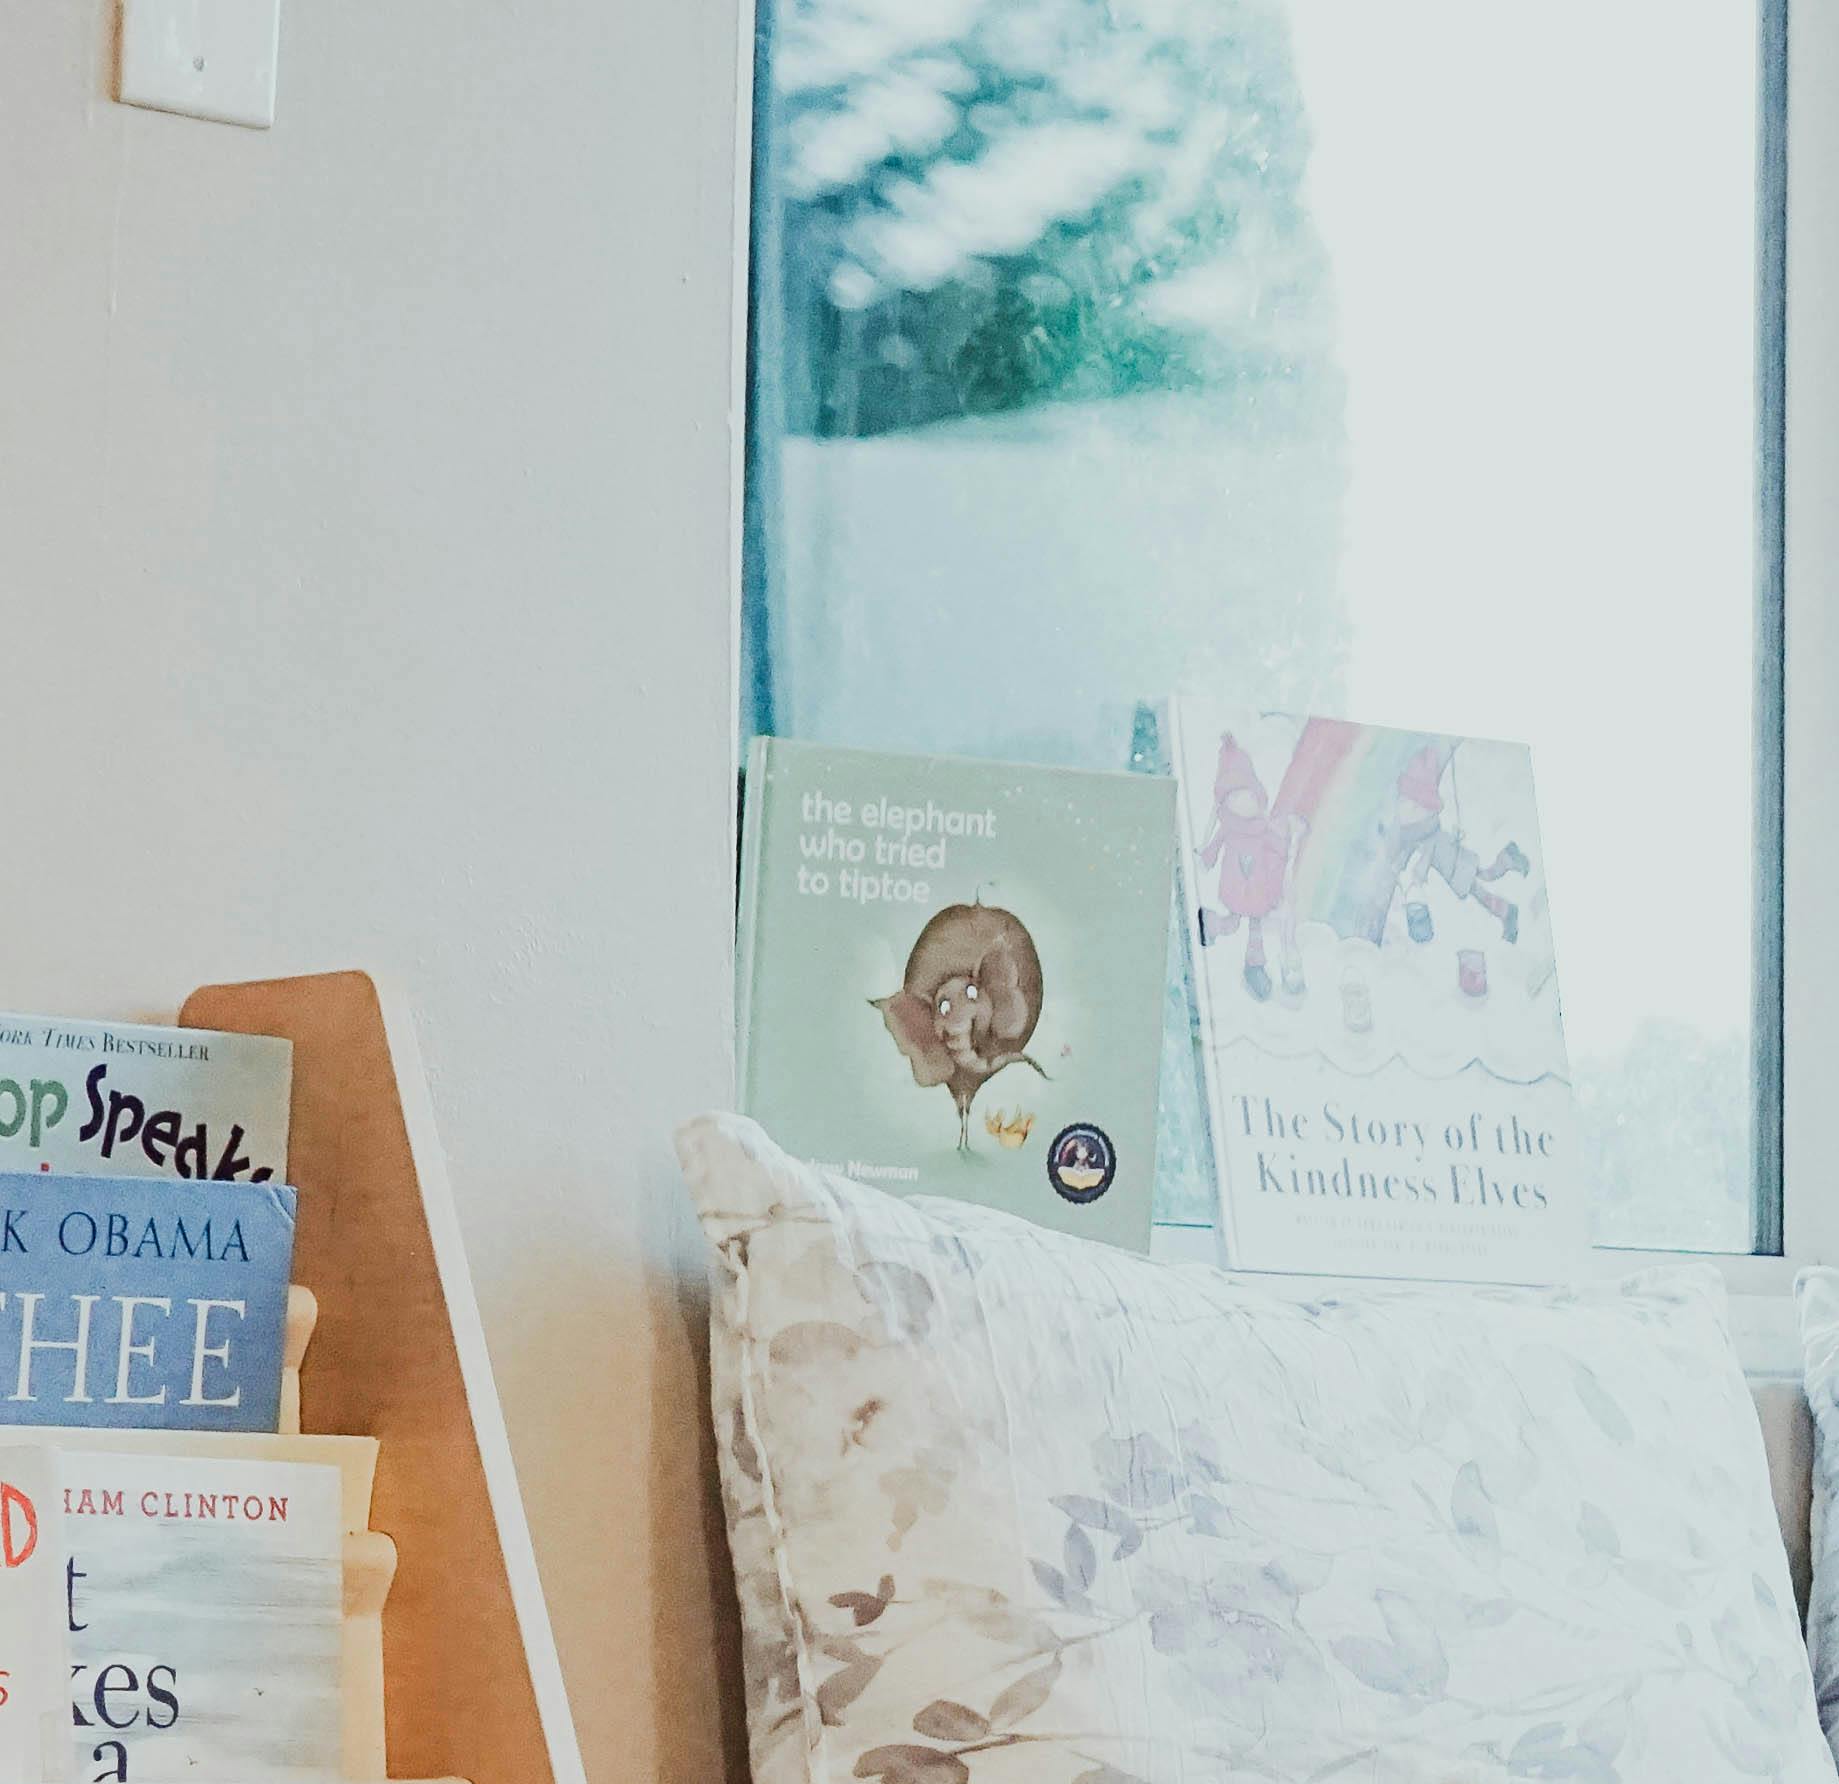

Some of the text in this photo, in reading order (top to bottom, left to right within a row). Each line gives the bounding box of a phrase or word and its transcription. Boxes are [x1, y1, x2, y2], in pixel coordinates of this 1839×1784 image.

[801, 790, 997, 838] the elephant
[799, 828, 946, 869] who tried
[796, 864, 931, 905] to tiptoe
[0, 1028, 209, 1061] ORK TIMES BESTSELLER
[1232, 1095, 1553, 1158] The Story of the
[1256, 1151, 1549, 1209] Kindness Elves
[58, 1211, 251, 1262] OBAMA
[0, 1292, 247, 1407] HEE
[140, 1491, 289, 1521] CLINTON
